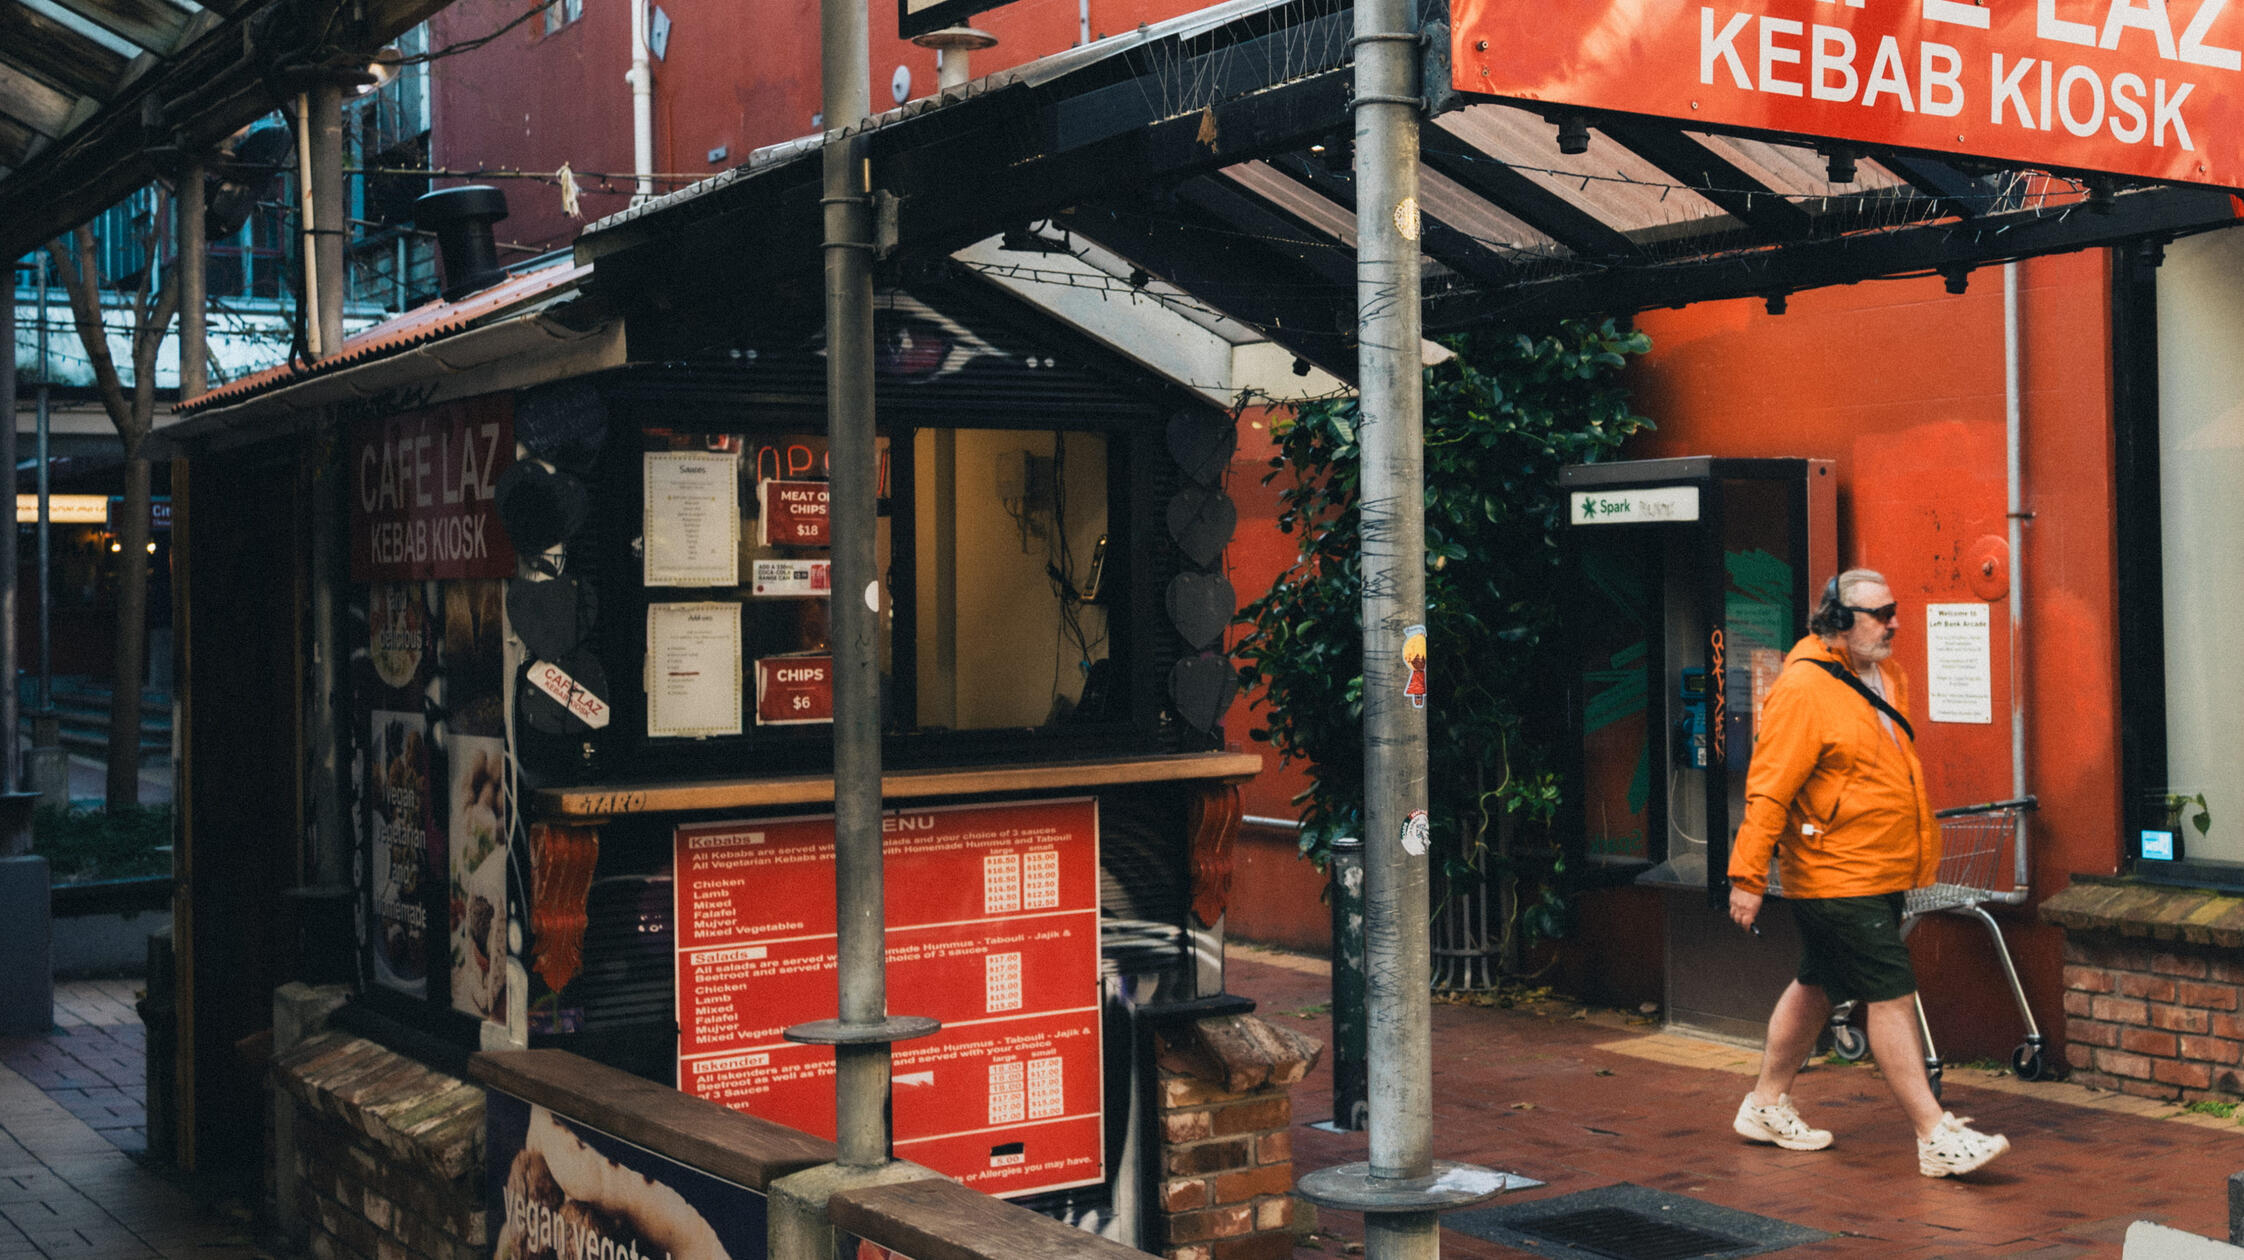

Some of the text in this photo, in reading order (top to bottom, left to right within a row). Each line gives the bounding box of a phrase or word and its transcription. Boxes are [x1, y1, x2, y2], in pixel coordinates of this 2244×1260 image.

[1700, 6, 2196, 152] KEBAB KIOSK
[360, 418, 432, 513] CAFÉ
[442, 422, 499, 505] LAZ
[781, 491, 815, 501] MEAT
[790, 504, 826, 514] CHIPS
[1600, 499, 1630, 516] Spark
[797, 524, 818, 536] $18
[371, 513, 487, 563] KEBAB KIOSK
[776, 668, 824, 682] CHIPS
[577, 691, 603, 716] LAZ
[793, 695, 811, 711] $6
[882, 816, 934, 832] ENU
[691, 834, 751, 848] Kebabs
[693, 827, 1056, 861] All Kebabs are served wit alads and your choice of 3 sauces
[693, 861, 708, 870] All
[711, 858, 772, 869] Vegetarian
[775, 854, 816, 864] Kebabs
[904, 842, 963, 854] Homemade
[966, 839, 1011, 848] Hummus
[1014, 837, 1033, 845] and
[1037, 833, 1072, 843] Tabouli
[693, 878, 745, 889] Chicken
[693, 889, 729, 899] Lamb
[693, 899, 732, 910] Mixed
[693, 908, 736, 919] Falafel
[694, 918, 737, 929] Mujver
[694, 922, 804, 938] Mixed Vegetables
[695, 966, 712, 975] All
[716, 962, 756, 973] salads
[760, 960, 779, 968] are
[782, 954, 824, 966] served
[885, 945, 920, 956] made
[923, 940, 974, 951] Hummus
[984, 935, 1024, 946] Tabouli
[1034, 931, 1060, 940] Jajik
[695, 950, 748, 965] Salads
[695, 971, 749, 983] Beetroot
[753, 967, 776, 977] and
[779, 963, 820, 974] served
[923, 950, 936, 959] of
[938, 949, 945, 957] 3
[948, 947, 988, 956] sauces
[695, 983, 747, 995] Chicken
[695, 994, 731, 1005] Lamb
[695, 1003, 734, 1015] Mixed
[695, 1012, 738, 1024] Falafel
[695, 1023, 739, 1034] Mujver
[696, 1026, 791, 1044] Mixed Vegetab
[697, 1074, 713, 1084] All
[781, 1064, 801, 1073] are
[804, 1060, 836, 1070] serve
[891, 1046, 940, 1059] memade
[943, 1039, 994, 1052] Hummus
[1005, 1033, 1044, 1043] Tabouli
[1054, 1028, 1079, 1038] Jajik
[1031, 1048, 1057, 1057] small
[696, 1056, 764, 1072] Iskender
[697, 1078, 751, 1092] Beetroot
[772, 1071, 797, 1082] well
[893, 1056, 915, 1066] and
[918, 1051, 957, 1063] served
[960, 1048, 984, 1058] with
[986, 1044, 1012, 1056] your
[1015, 1040, 1052, 1050] choice
[713, 1090, 721, 1099] 3
[724, 1085, 770, 1097] Sauces
[966, 1173, 977, 1181] or
[979, 1166, 1022, 1179] Allergies
[1024, 1164, 1043, 1174] you
[1044, 1160, 1065, 1169] may
[1067, 1156, 1093, 1165] have.
